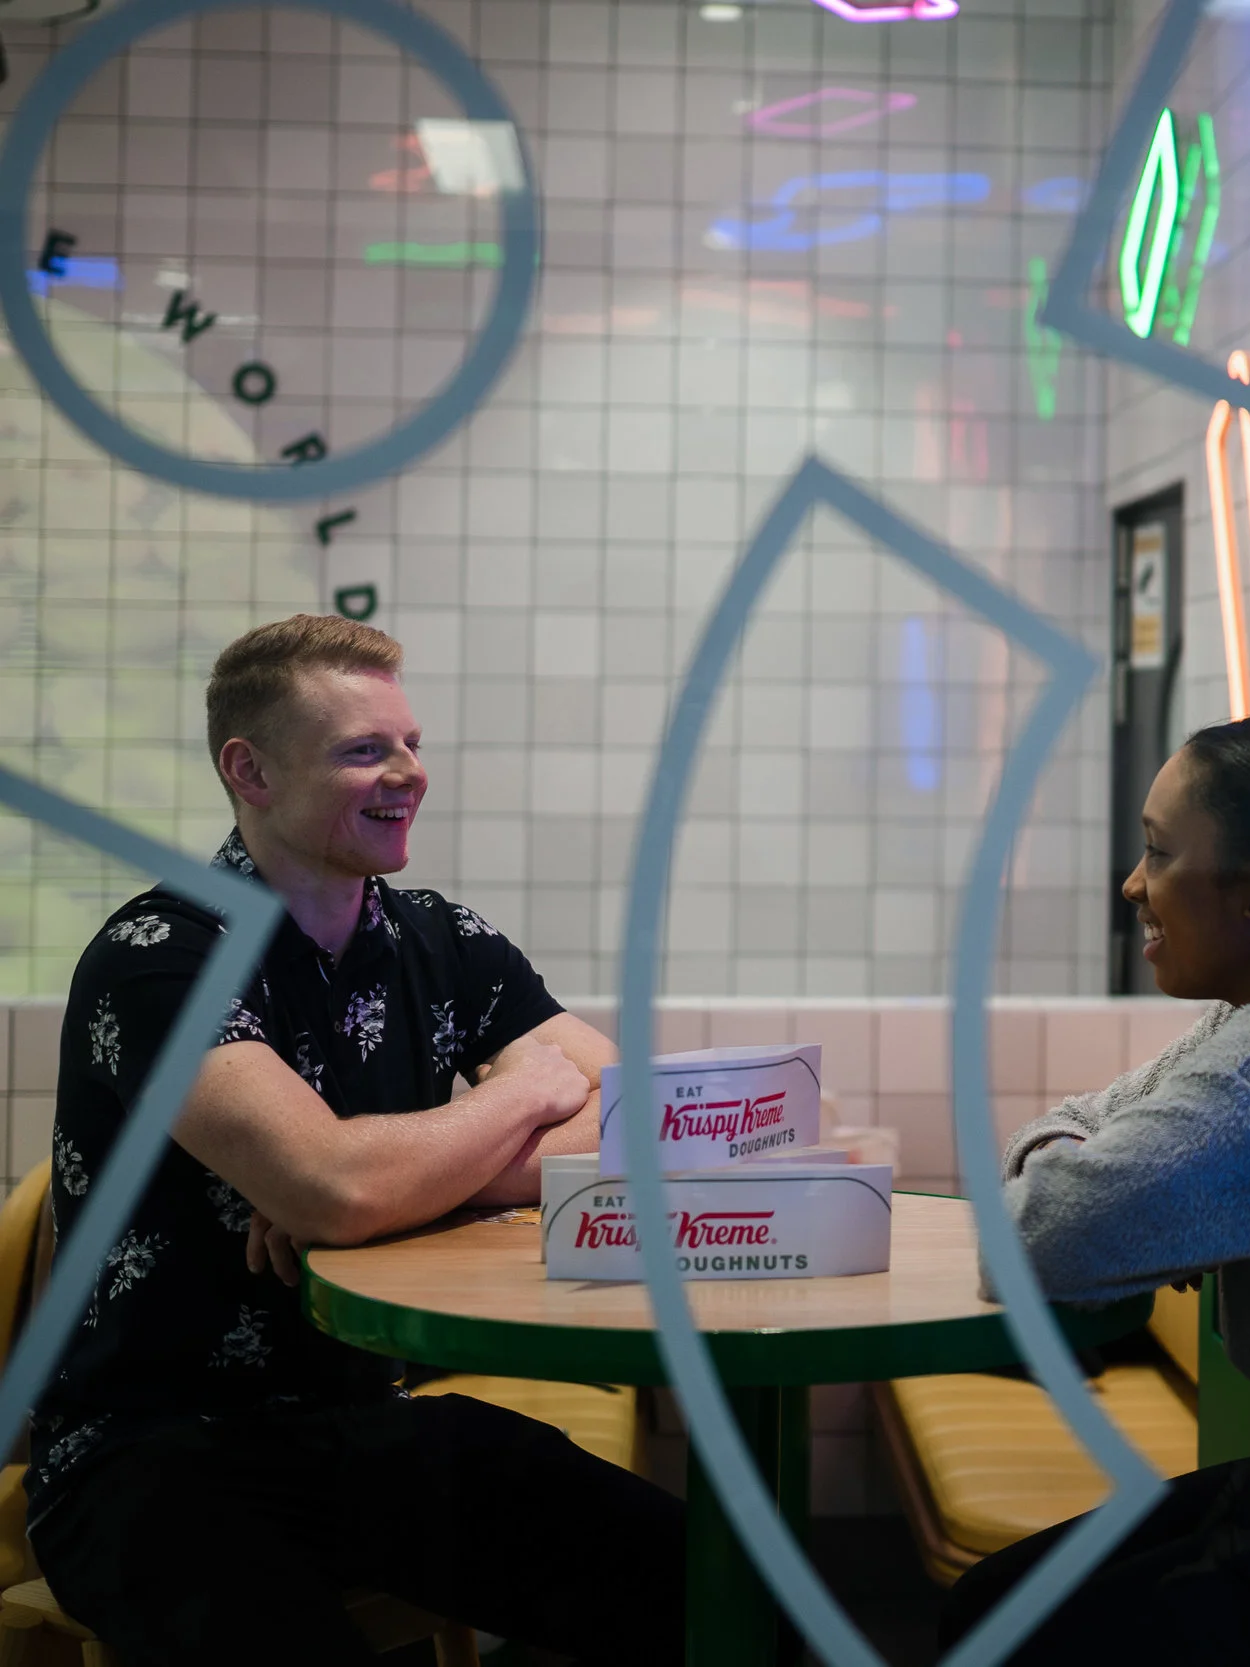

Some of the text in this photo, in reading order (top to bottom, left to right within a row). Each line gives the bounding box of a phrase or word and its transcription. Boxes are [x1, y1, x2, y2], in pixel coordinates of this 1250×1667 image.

[161, 289, 378, 621] WORLD
[676, 1086, 703, 1098] EAT
[659, 1091, 787, 1142] Krispy Kreme
[729, 1128, 796, 1158] DOUGHNUTS
[593, 1196, 626, 1207] EAT
[575, 1211, 775, 1251] Kris Kreme
[675, 1254, 808, 1272] OUGHNUTS
